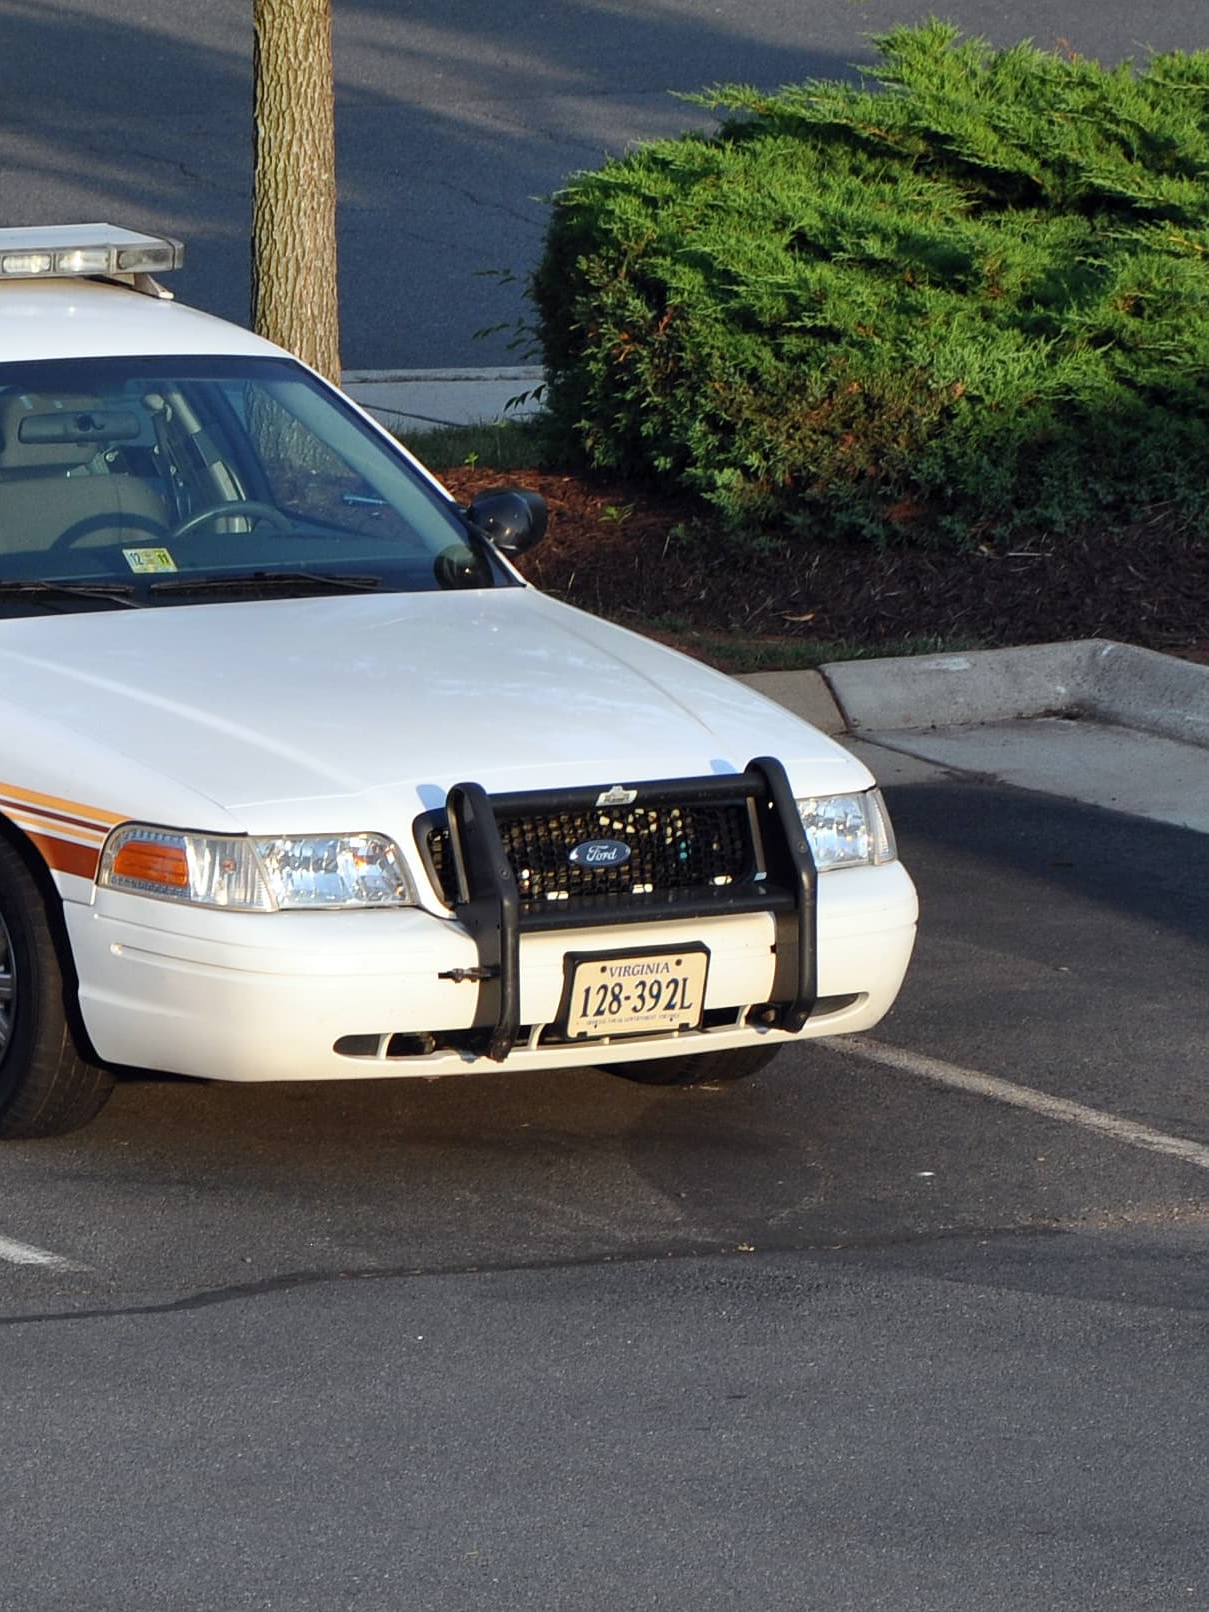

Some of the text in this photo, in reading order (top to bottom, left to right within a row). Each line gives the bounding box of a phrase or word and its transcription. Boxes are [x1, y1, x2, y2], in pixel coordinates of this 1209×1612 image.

[586, 845, 618, 862] Ford
[609, 962, 671, 978] VIRGINIA
[580, 977, 693, 1018] 128-392L
